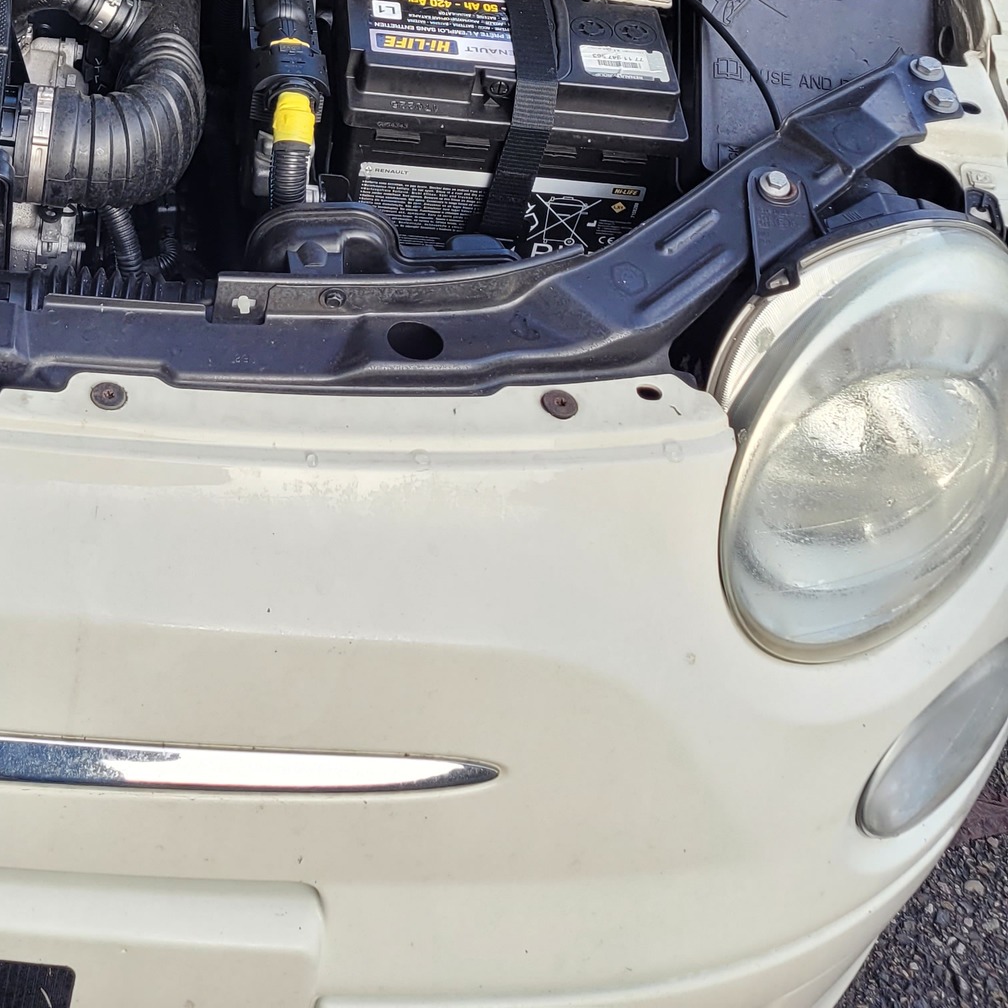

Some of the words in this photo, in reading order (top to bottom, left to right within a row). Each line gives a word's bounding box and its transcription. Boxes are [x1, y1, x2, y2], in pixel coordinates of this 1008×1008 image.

[377, 4, 396, 15] L1
[464, 1, 480, 11] Ah
[483, 3, 498, 12] 50
[373, 21, 415, 32] ENTRETIEN
[415, 25, 436, 33] SANS
[437, 27, 471, 37] L'EMPLOI
[472, 30, 479, 38] À
[480, 31, 504, 39] PRÊTE
[383, 35, 451, 53] Hi-LIFE
[748, 68, 792, 87] USE
[798, 74, 832, 91] AND
